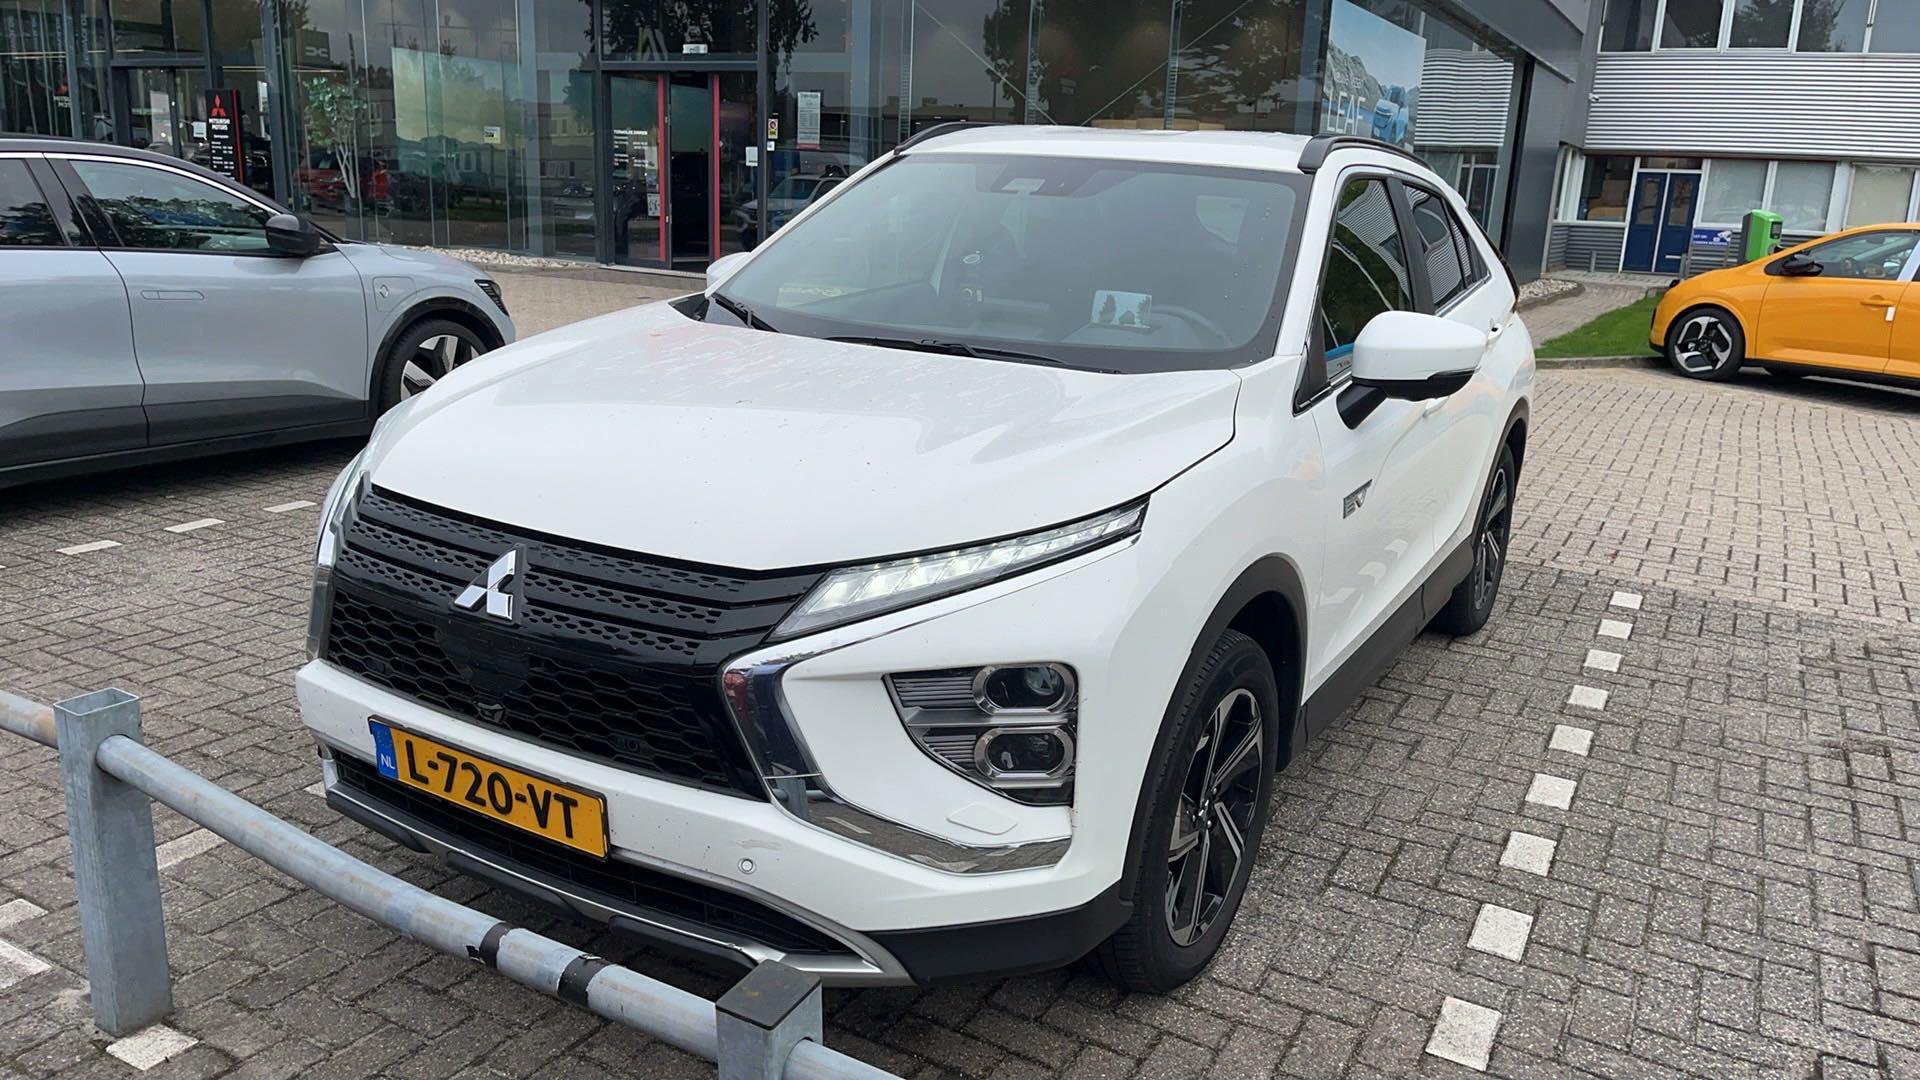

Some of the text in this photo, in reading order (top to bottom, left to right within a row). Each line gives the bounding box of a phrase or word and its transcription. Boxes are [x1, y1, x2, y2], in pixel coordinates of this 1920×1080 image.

[1327, 88, 1366, 136] LEAF
[381, 753, 396, 770] NL
[405, 739, 578, 839] L-720-VT
